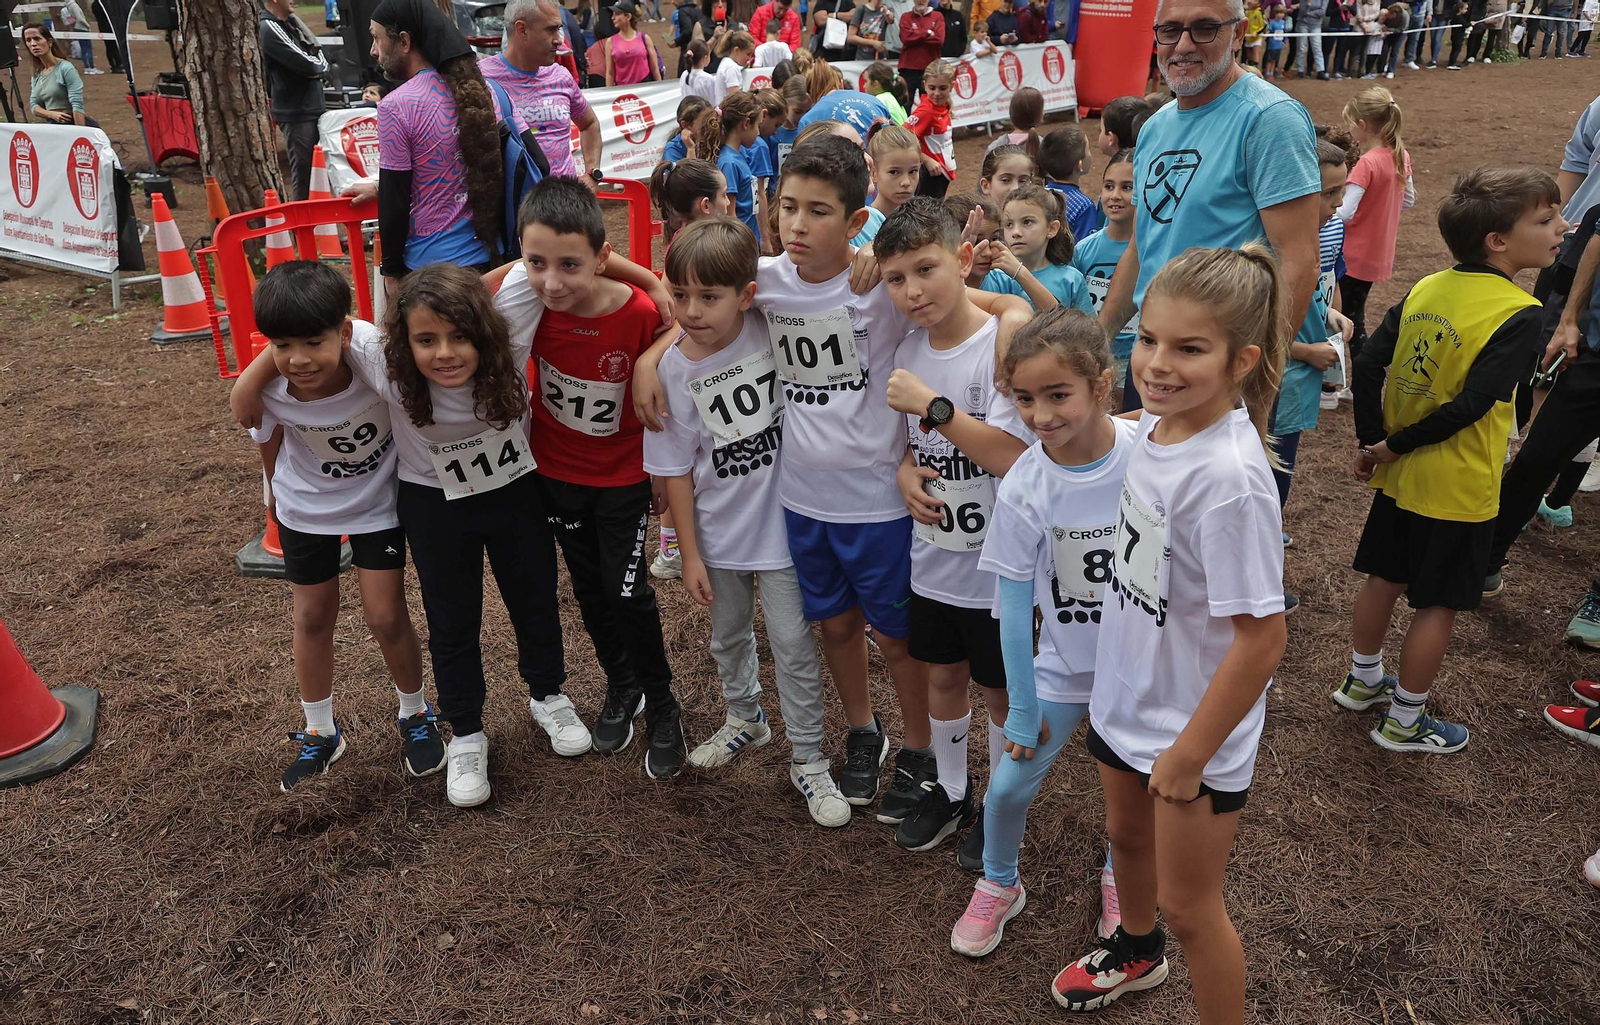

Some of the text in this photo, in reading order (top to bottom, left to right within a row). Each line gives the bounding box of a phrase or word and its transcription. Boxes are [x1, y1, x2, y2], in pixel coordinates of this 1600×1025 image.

[775, 316, 805, 326] CROSS
[1402, 313, 1462, 349] ETISMO ESTEPONA
[778, 333, 844, 368] 101
[550, 369, 588, 390] CROSS
[704, 365, 744, 388] CROSS
[546, 381, 616, 424] 212
[708, 369, 777, 425] 107
[310, 420, 351, 432] CROSS
[328, 422, 378, 454] 69
[441, 438, 483, 453] CROSS
[444, 439, 520, 483] 114
[926, 478, 946, 492] ROSS
[933, 502, 985, 534] 06
[620, 528, 645, 597] KELME
[1083, 549, 1113, 583] 8
